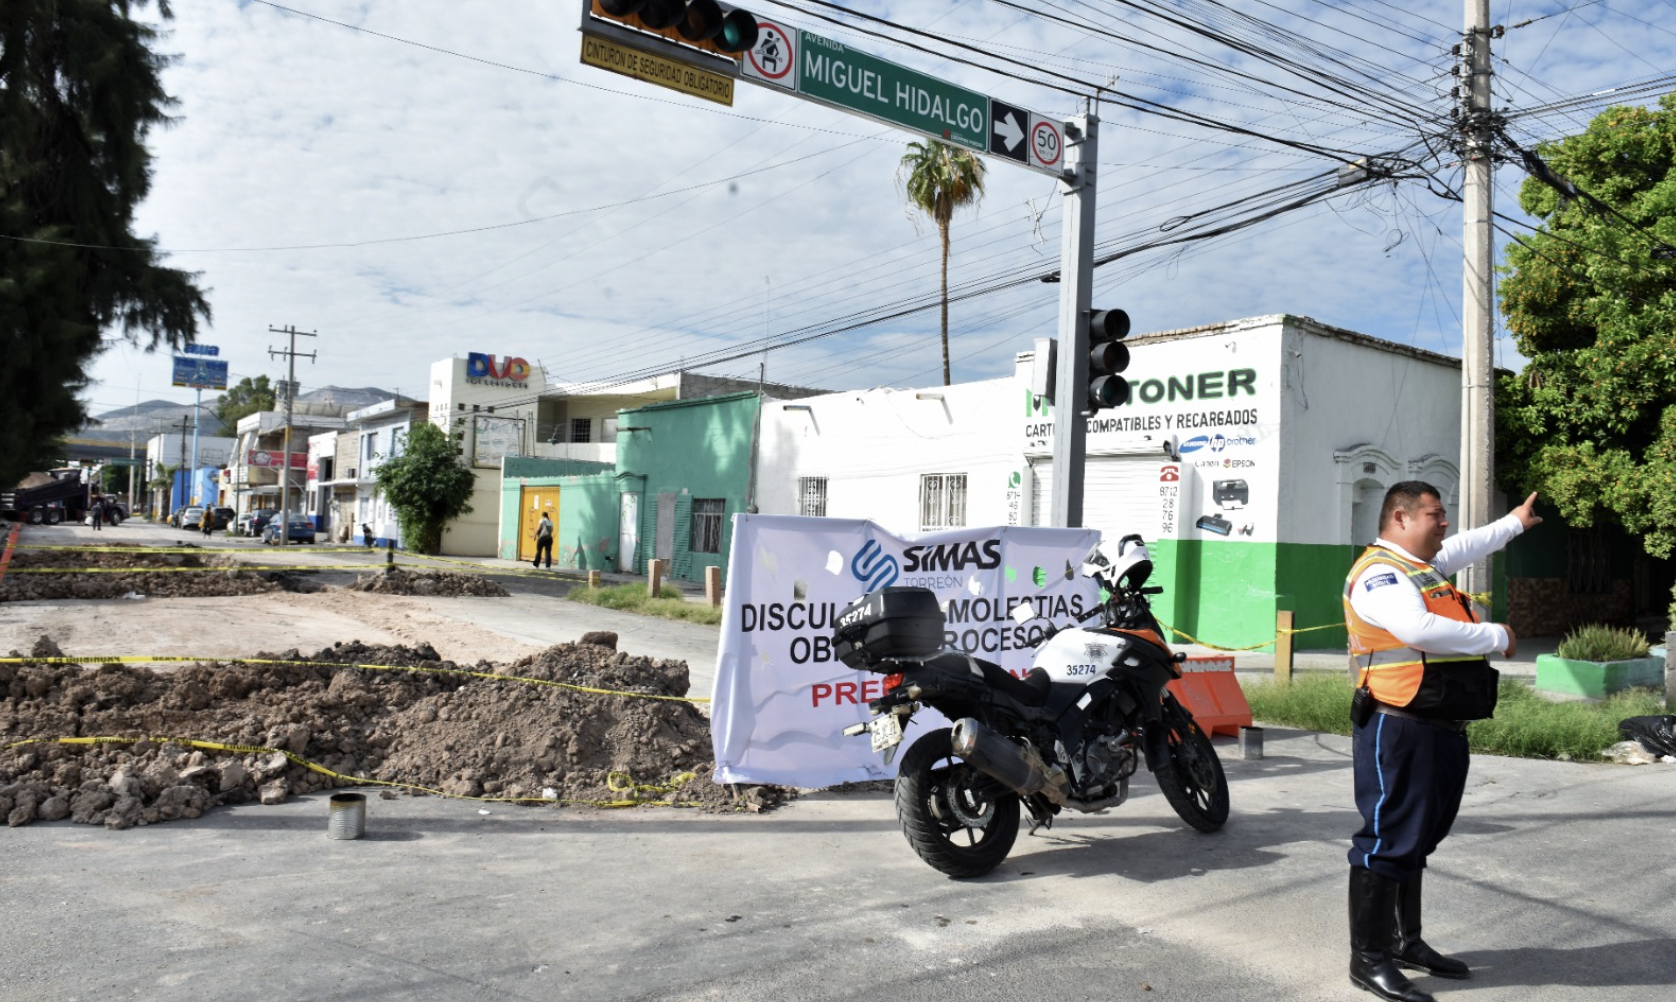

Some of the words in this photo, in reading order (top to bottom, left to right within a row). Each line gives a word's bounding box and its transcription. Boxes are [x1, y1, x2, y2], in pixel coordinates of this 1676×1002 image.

[805, 33, 844, 53] AVENIDA
[586, 41, 626, 67] CINTURON
[627, 54, 637, 71] DE
[639, 57, 681, 84] SEGURIDAD
[684, 71, 730, 98] OBLIGATORIO
[805, 50, 889, 103] MIGUEL
[896, 81, 983, 133] HIDALGO
[1037, 129, 1056, 150] 50
[1125, 368, 1257, 405] TONER
[1086, 416, 1161, 434] COMPATIBLES
[1165, 415, 1173, 429] Y
[1177, 409, 1258, 429] RECARGADOS
[1227, 437, 1256, 446] brother
[1232, 459, 1255, 468] EPSON
[1162, 498, 1174, 509] 28
[1162, 510, 1174, 521] 76
[1162, 522, 1174, 533] 96
[742, 602, 853, 632] DISCUL
[948, 594, 1083, 624] MOLETIAS
[839, 603, 871, 629] 35274
[790, 636, 839, 664] OB
[941, 625, 1044, 654] ROCESO
[1066, 664, 1096, 676] 35274
